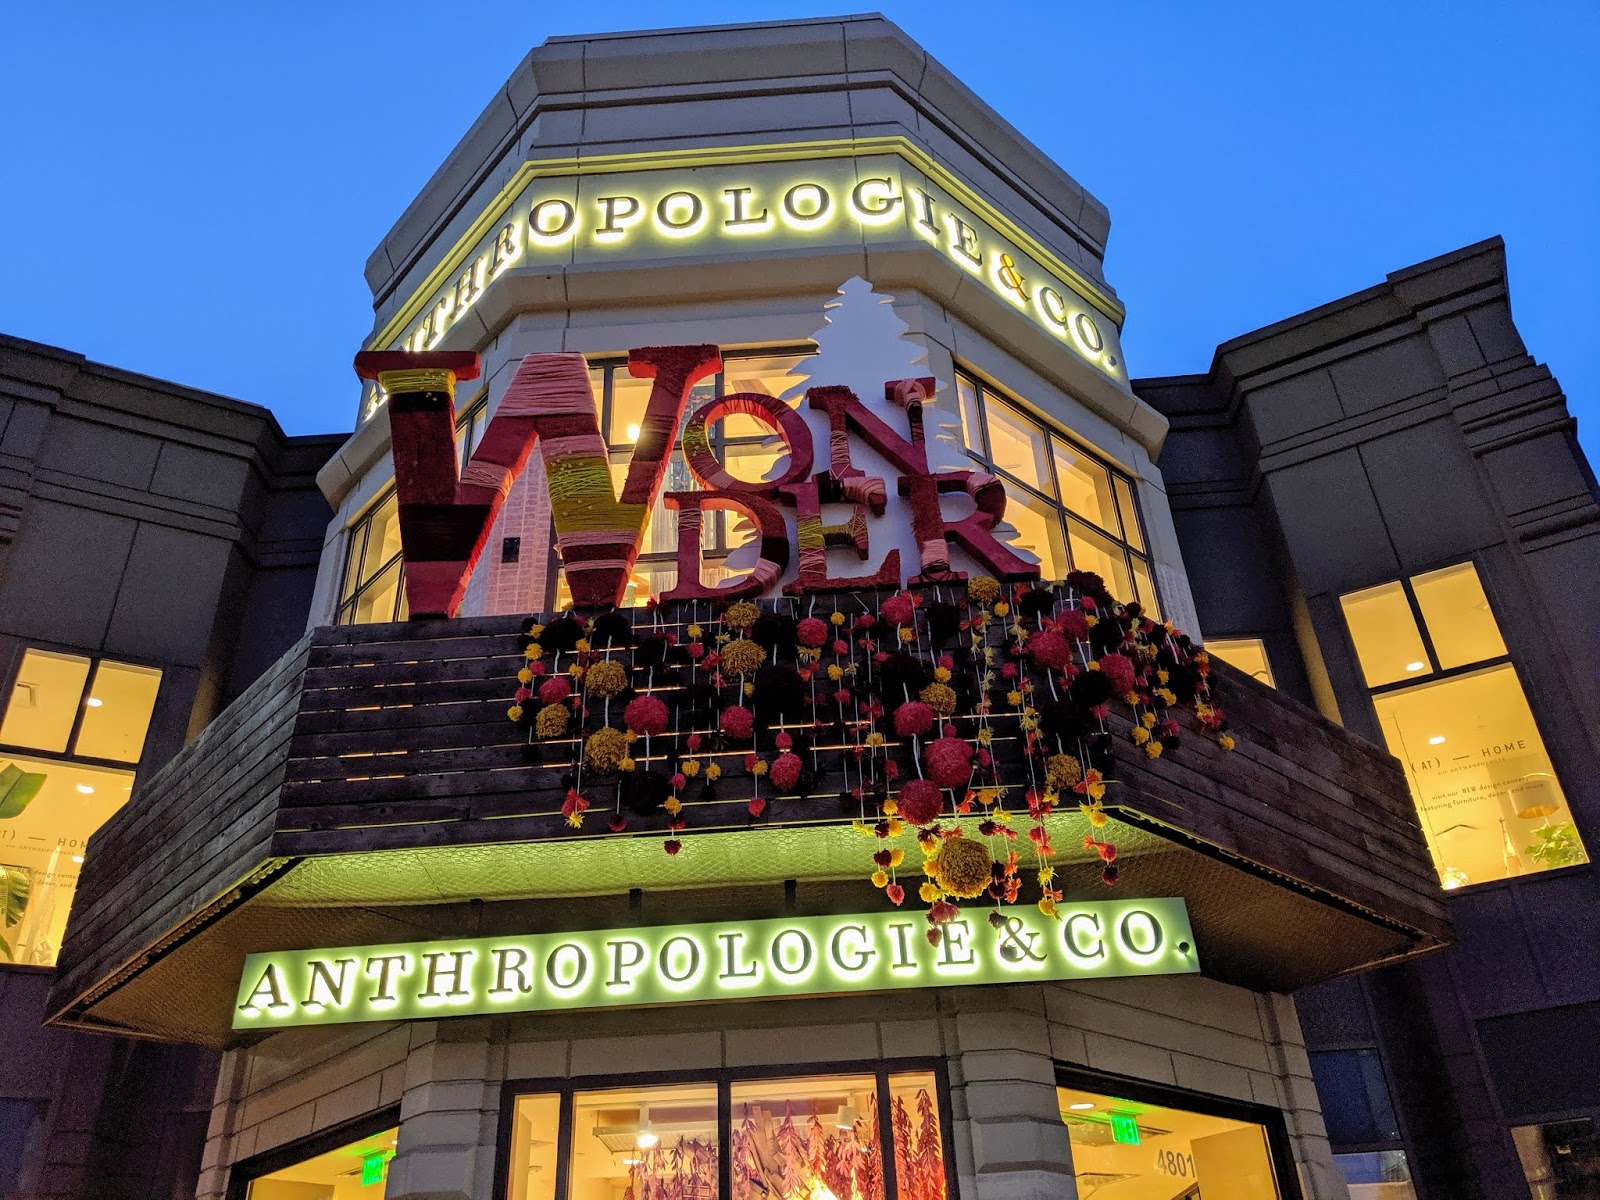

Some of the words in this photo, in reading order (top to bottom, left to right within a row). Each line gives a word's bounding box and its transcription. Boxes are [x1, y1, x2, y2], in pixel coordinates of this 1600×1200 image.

[1481, 740, 1526, 757] HOME
[1461, 786, 1477, 794] NEW
[1157, 1149, 1195, 1179] 4801
